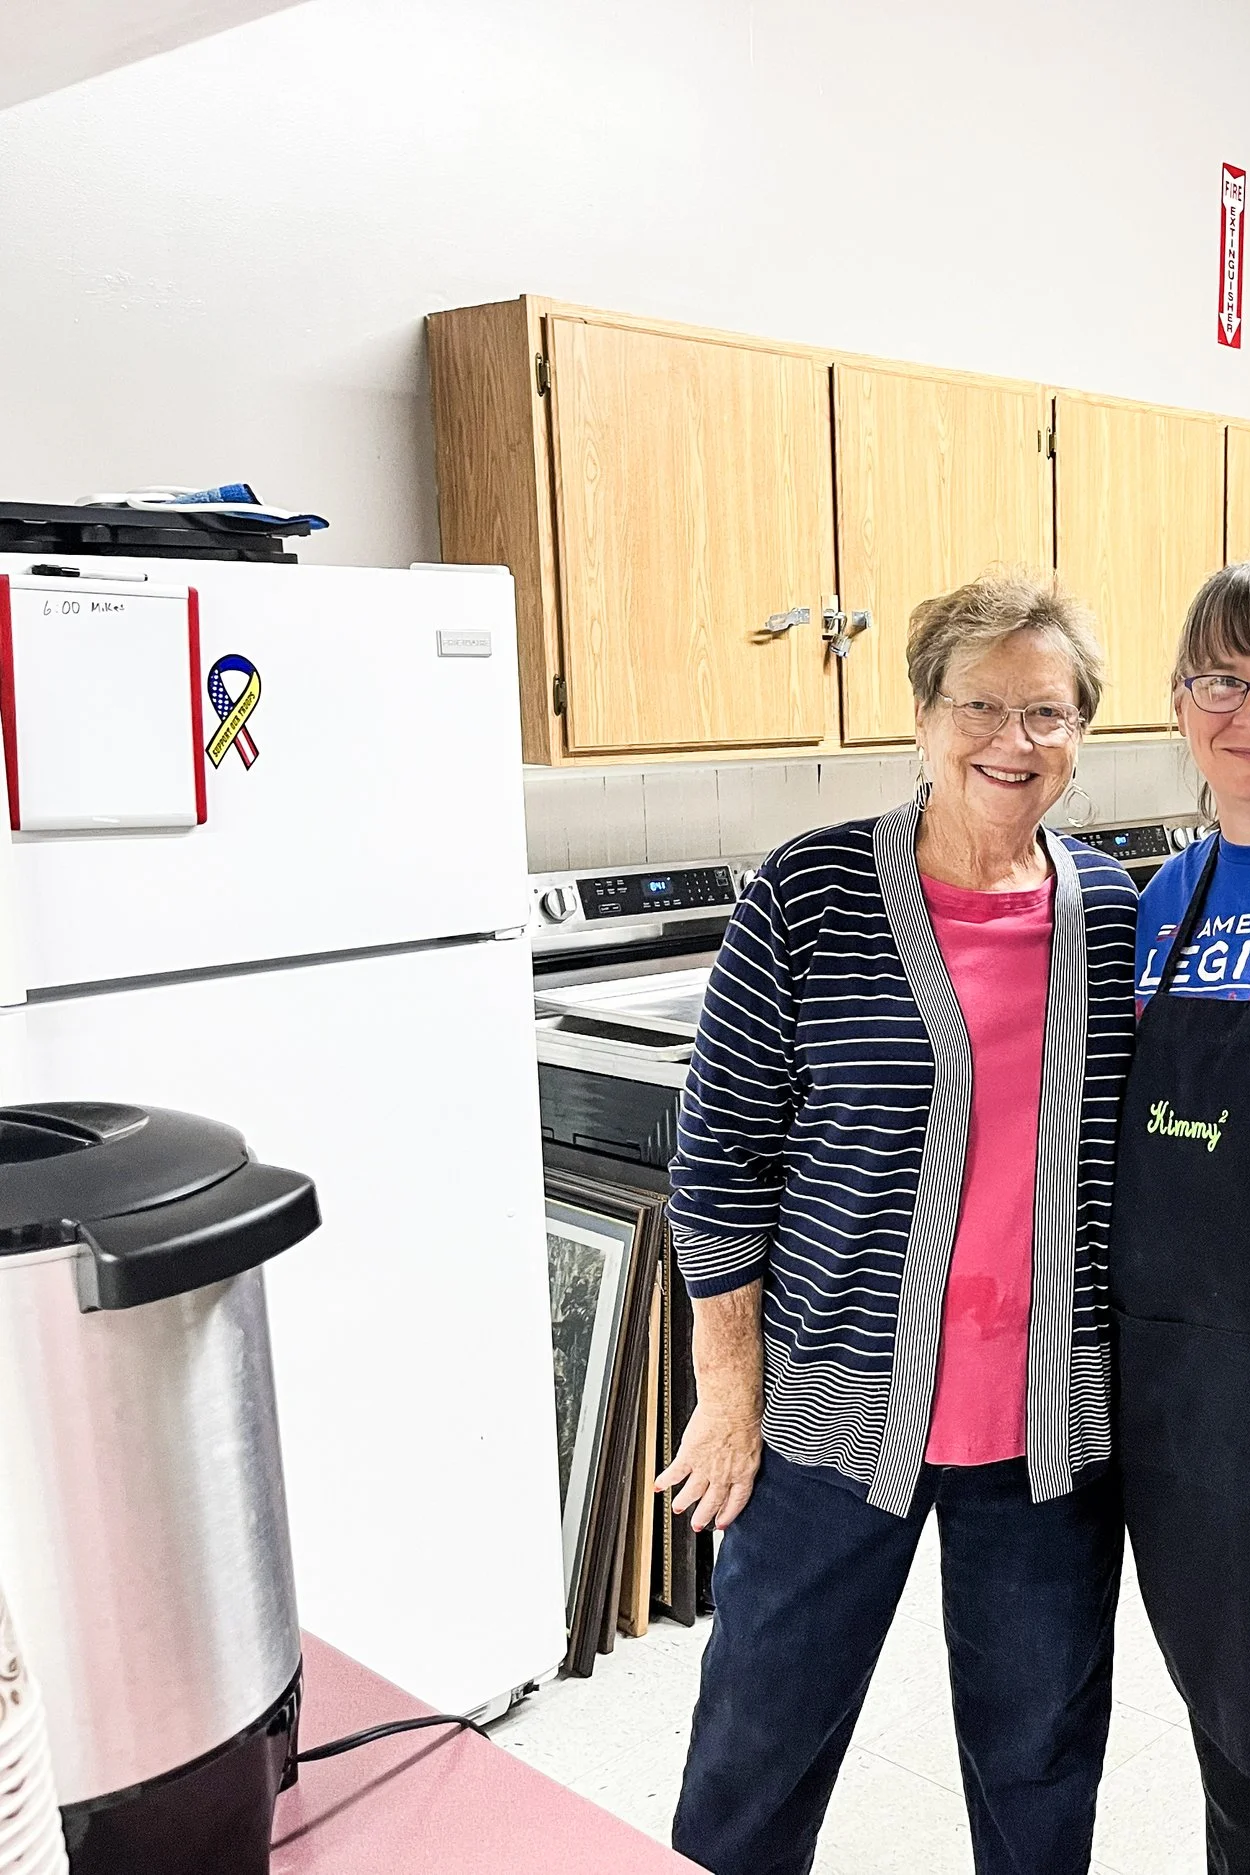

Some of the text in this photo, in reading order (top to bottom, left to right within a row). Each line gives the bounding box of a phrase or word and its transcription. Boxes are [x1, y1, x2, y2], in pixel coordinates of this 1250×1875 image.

[1225, 181, 1242, 201] FIRE
[1227, 206, 1237, 333] EXTINGUISHER
[43, 600, 80, 616] 6:00
[212, 691, 257, 758] SUPPORT OUR TROOPS
